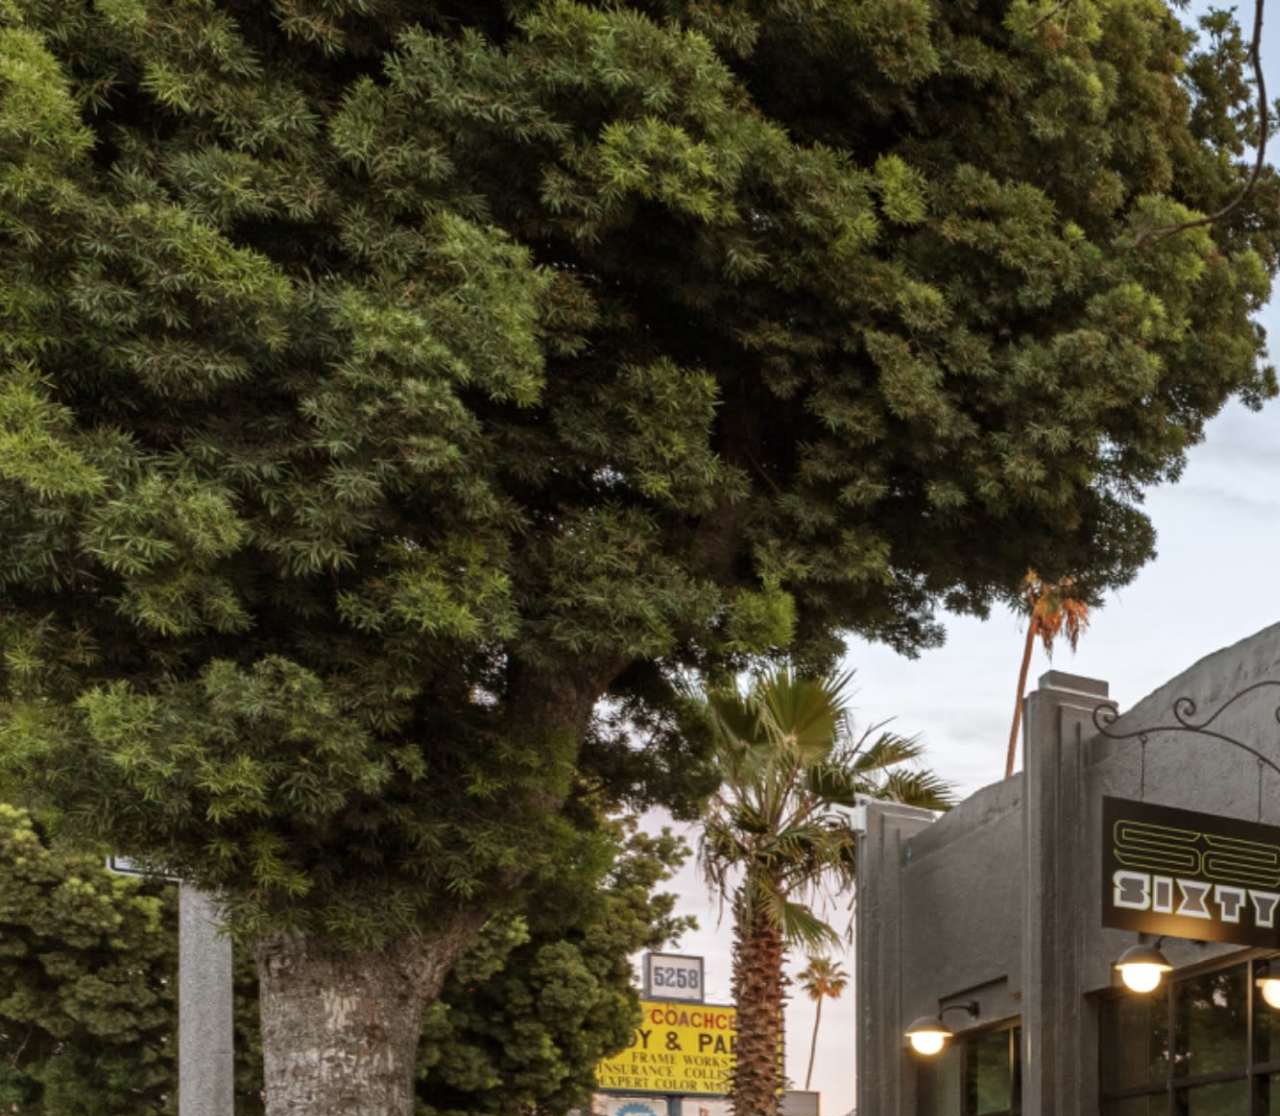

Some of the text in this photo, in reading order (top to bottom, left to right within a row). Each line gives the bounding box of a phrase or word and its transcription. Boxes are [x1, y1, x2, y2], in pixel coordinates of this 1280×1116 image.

[653, 966, 699, 989] 5258
[666, 1031, 682, 1051] &
[632, 1052, 729, 1067] FRAME WORKS
[599, 1063, 674, 1077] INSURANCE
[655, 1079, 698, 1089] COLOR
